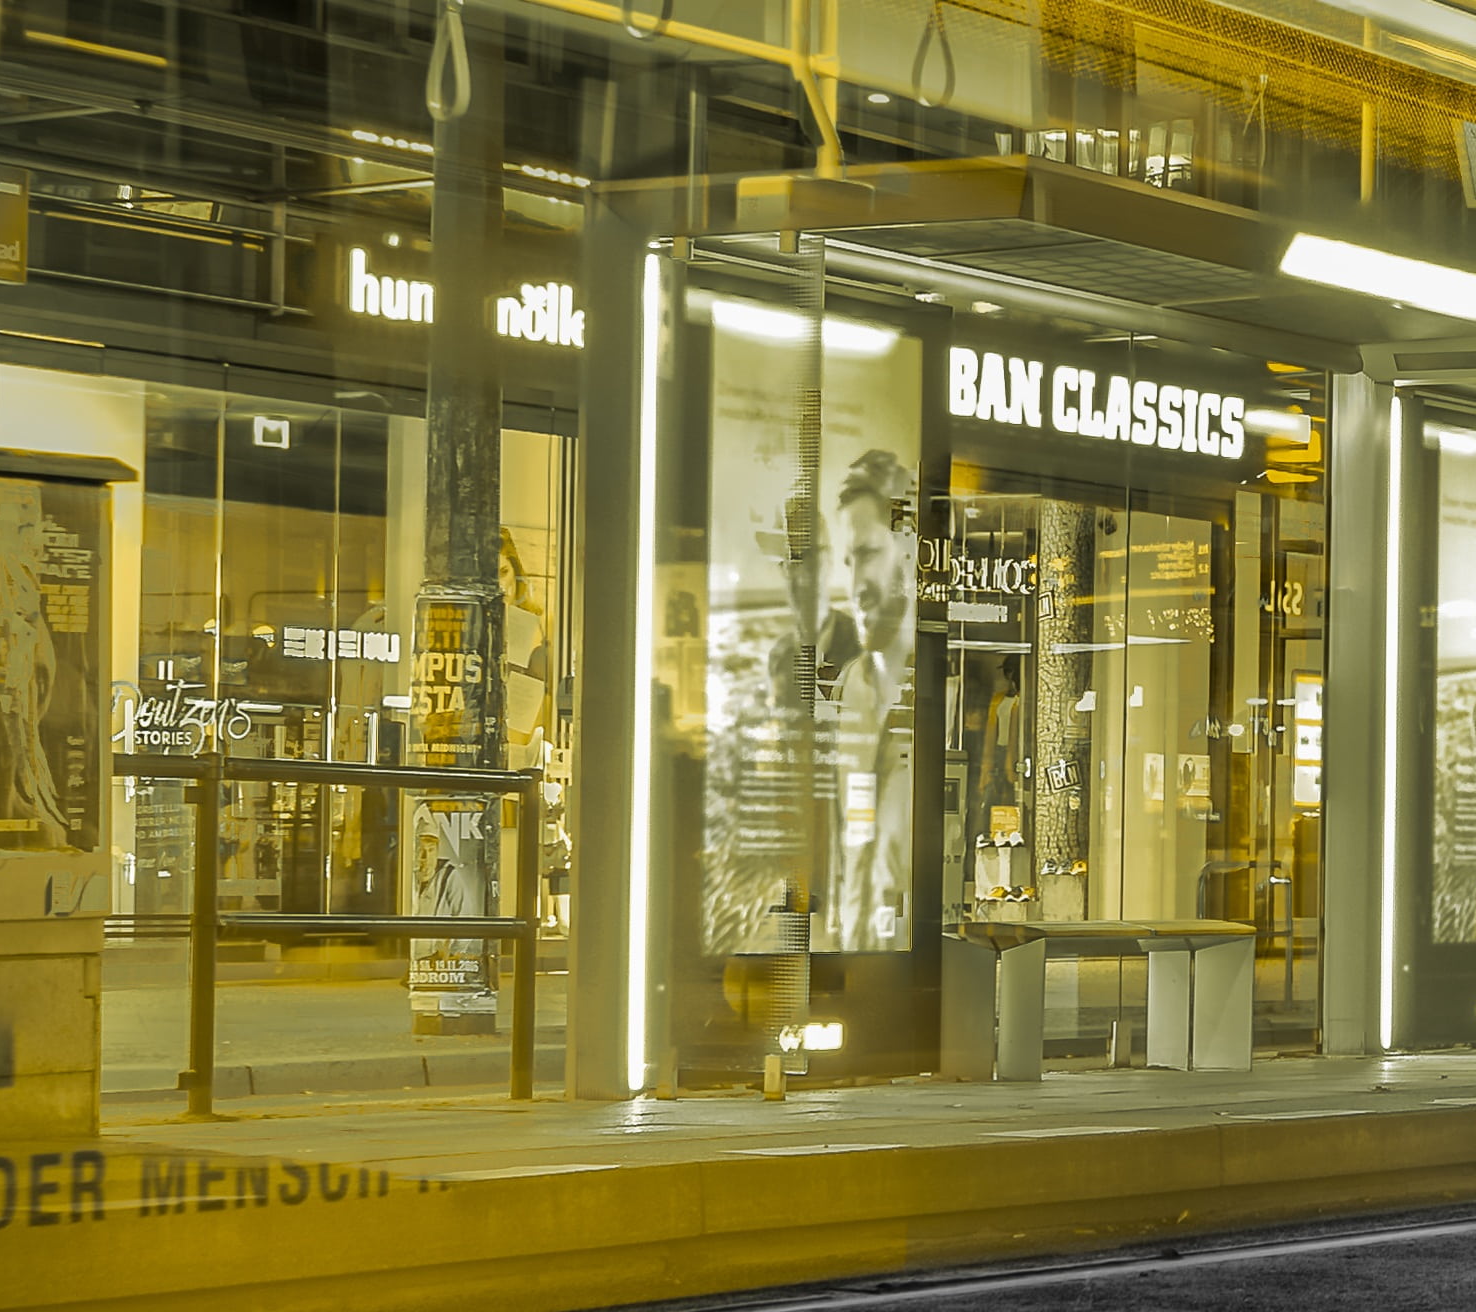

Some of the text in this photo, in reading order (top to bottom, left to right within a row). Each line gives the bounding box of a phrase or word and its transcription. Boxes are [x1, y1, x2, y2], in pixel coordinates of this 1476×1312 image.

[949, 346, 1244, 460] BAN CLASSICS
[135, 731, 192, 745] STORIES
